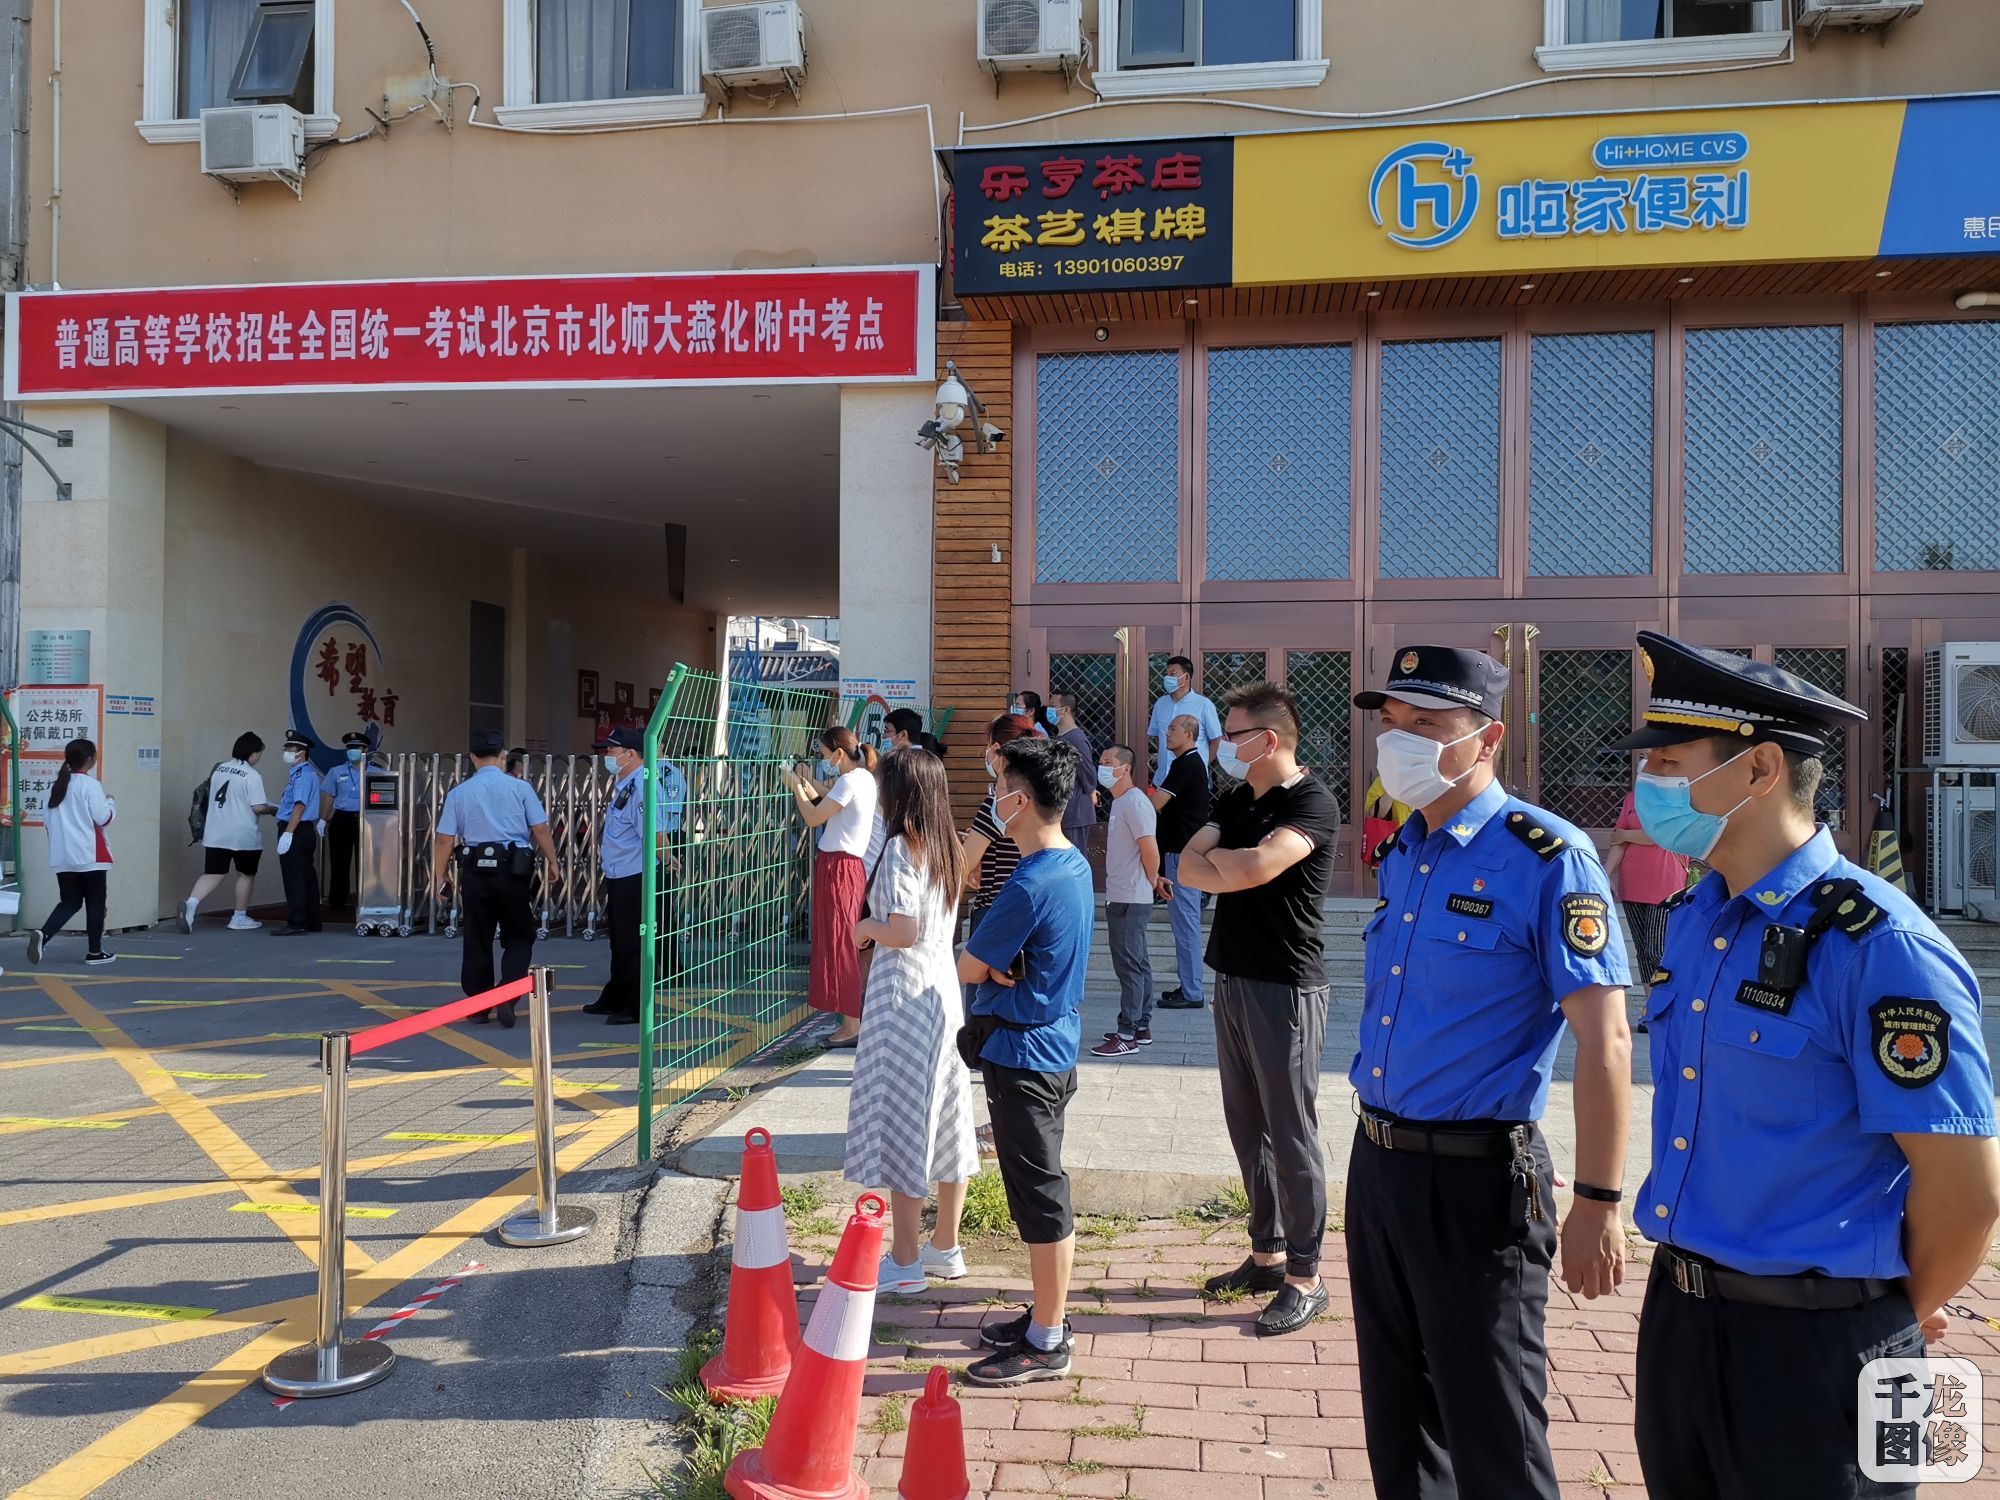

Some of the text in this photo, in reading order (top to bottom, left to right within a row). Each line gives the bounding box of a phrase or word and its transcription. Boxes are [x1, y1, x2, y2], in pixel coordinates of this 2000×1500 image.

[1700, 139, 1738, 156] CVS
[980, 152, 1202, 202] 乐亨茶庄
[1497, 169, 1750, 240] 嗨家便利
[980, 202, 1207, 253] 茶艺棋牌
[54, 296, 886, 369] 普通高等学校招生全国统一考试北京市北师大燕化附中考点
[26, 708, 83, 723] 公共场所
[18, 726, 89, 740] 请佩戴口罩
[18, 778, 57, 793] 非本
[214, 779, 231, 809] 4
[1451, 898, 1490, 915] 11100367
[1742, 985, 1787, 1009] 11100334
[1878, 1006, 1942, 1026] 中华人民共和国
[1883, 1020, 1937, 1032] 城市管理执法
